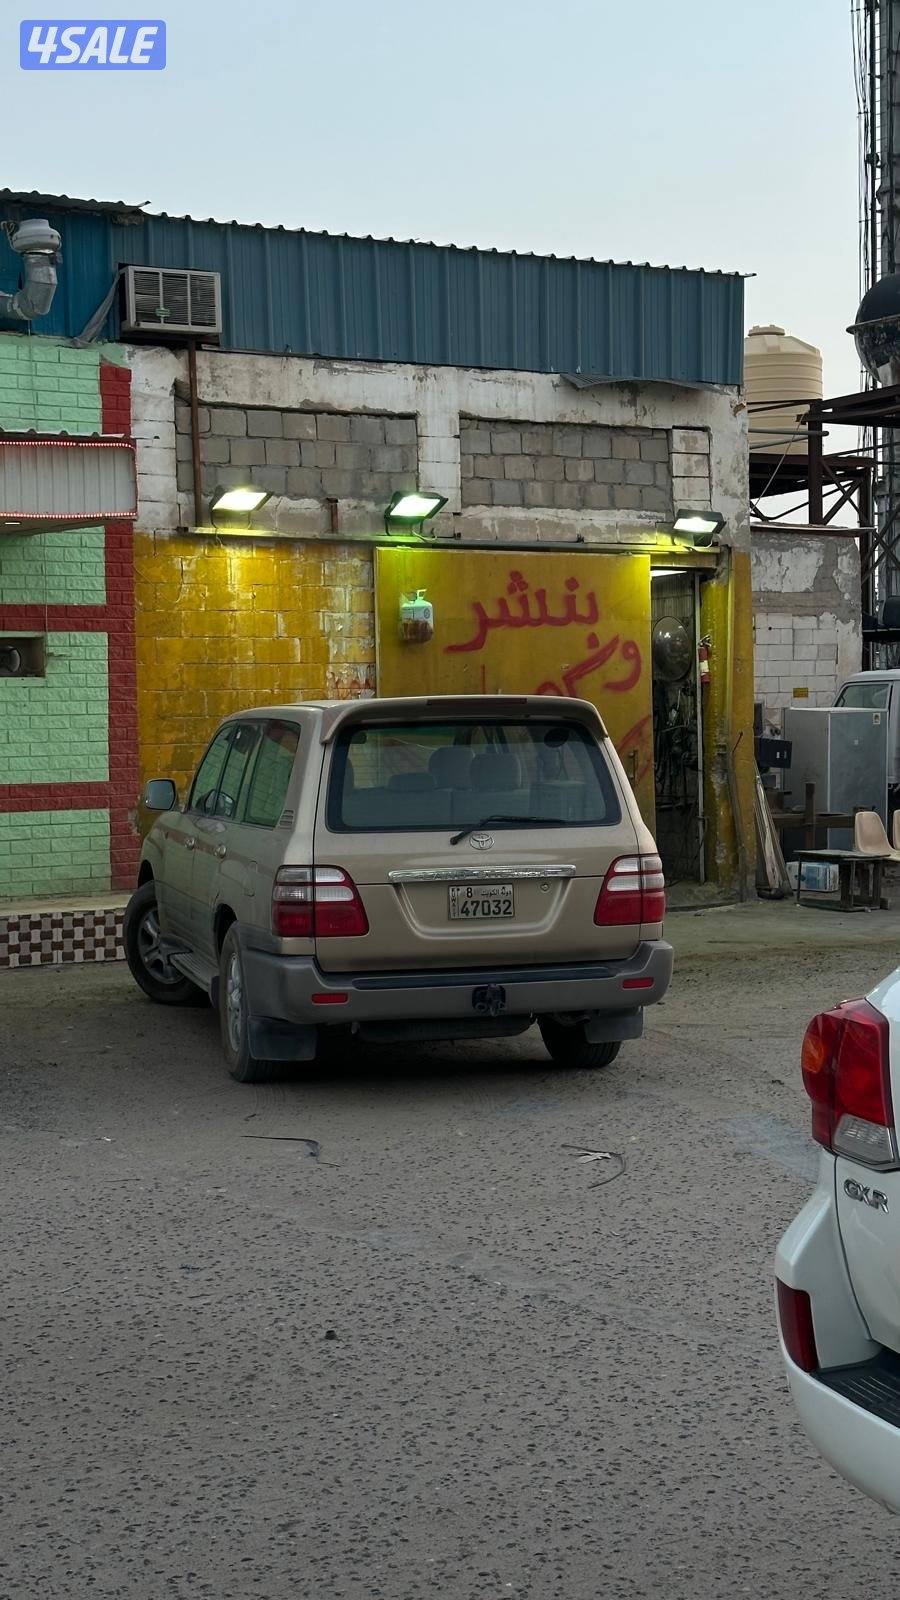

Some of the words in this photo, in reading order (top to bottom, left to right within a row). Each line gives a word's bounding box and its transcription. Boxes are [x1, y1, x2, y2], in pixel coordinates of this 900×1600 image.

[443, 570, 599, 655] بنشر
[466, 886, 474, 898] 8
[460, 899, 513, 917] 47032
[843, 1178, 890, 1214] GXR
